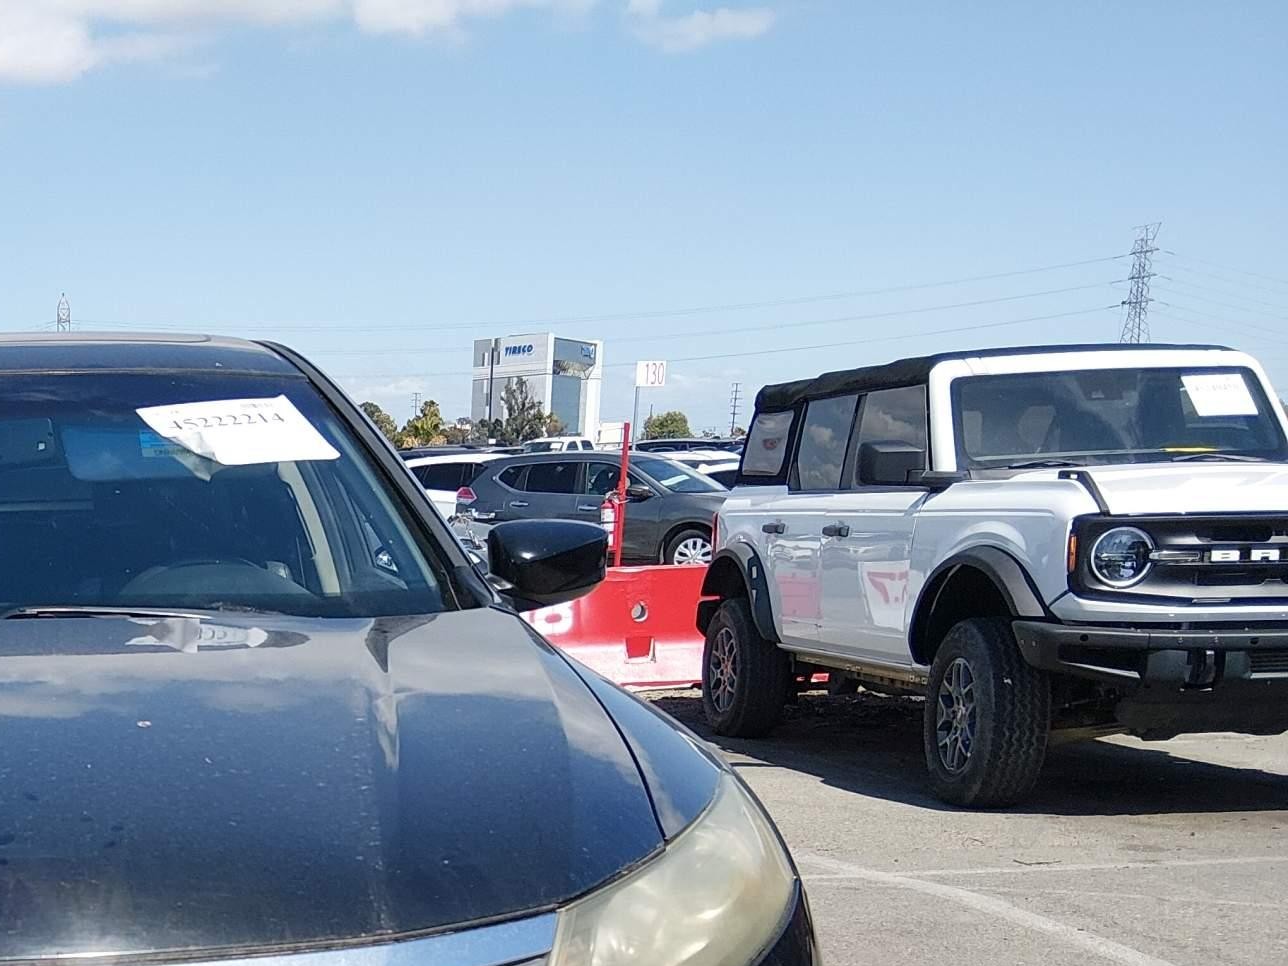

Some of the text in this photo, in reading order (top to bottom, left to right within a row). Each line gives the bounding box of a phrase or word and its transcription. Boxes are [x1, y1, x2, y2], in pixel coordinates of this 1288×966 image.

[505, 344, 534, 357] TIRECO
[646, 362, 665, 385] 130
[168, 412, 285, 430] 45222214
